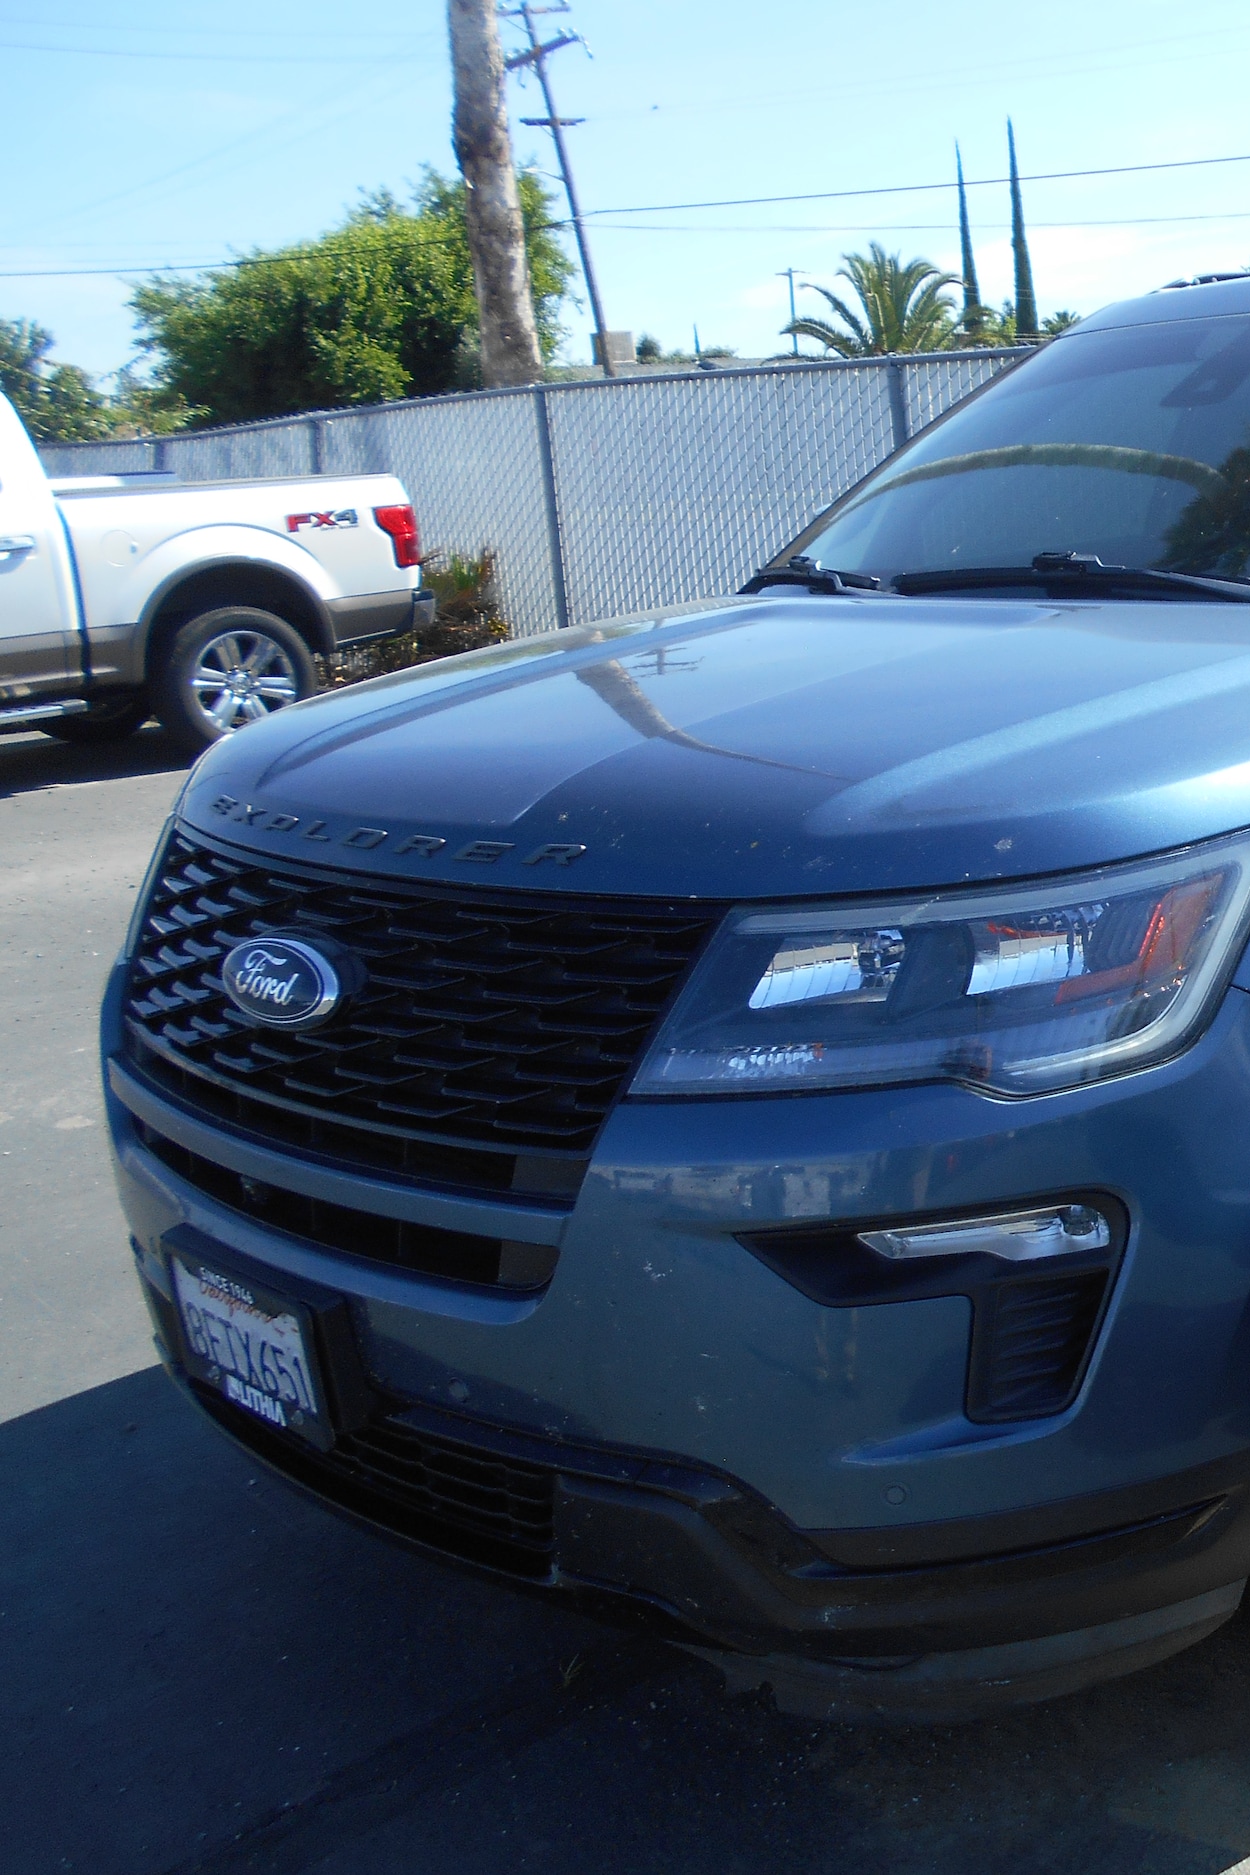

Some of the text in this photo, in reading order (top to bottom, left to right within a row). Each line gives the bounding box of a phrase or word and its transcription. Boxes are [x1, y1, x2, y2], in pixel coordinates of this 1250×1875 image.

[286, 508, 358, 533] FX4
[212, 794, 587, 866] EXPLORER
[235, 949, 299, 1006] Ford
[200, 1265, 229, 1293] SINCE
[240, 1380, 287, 1427] LITHIA
